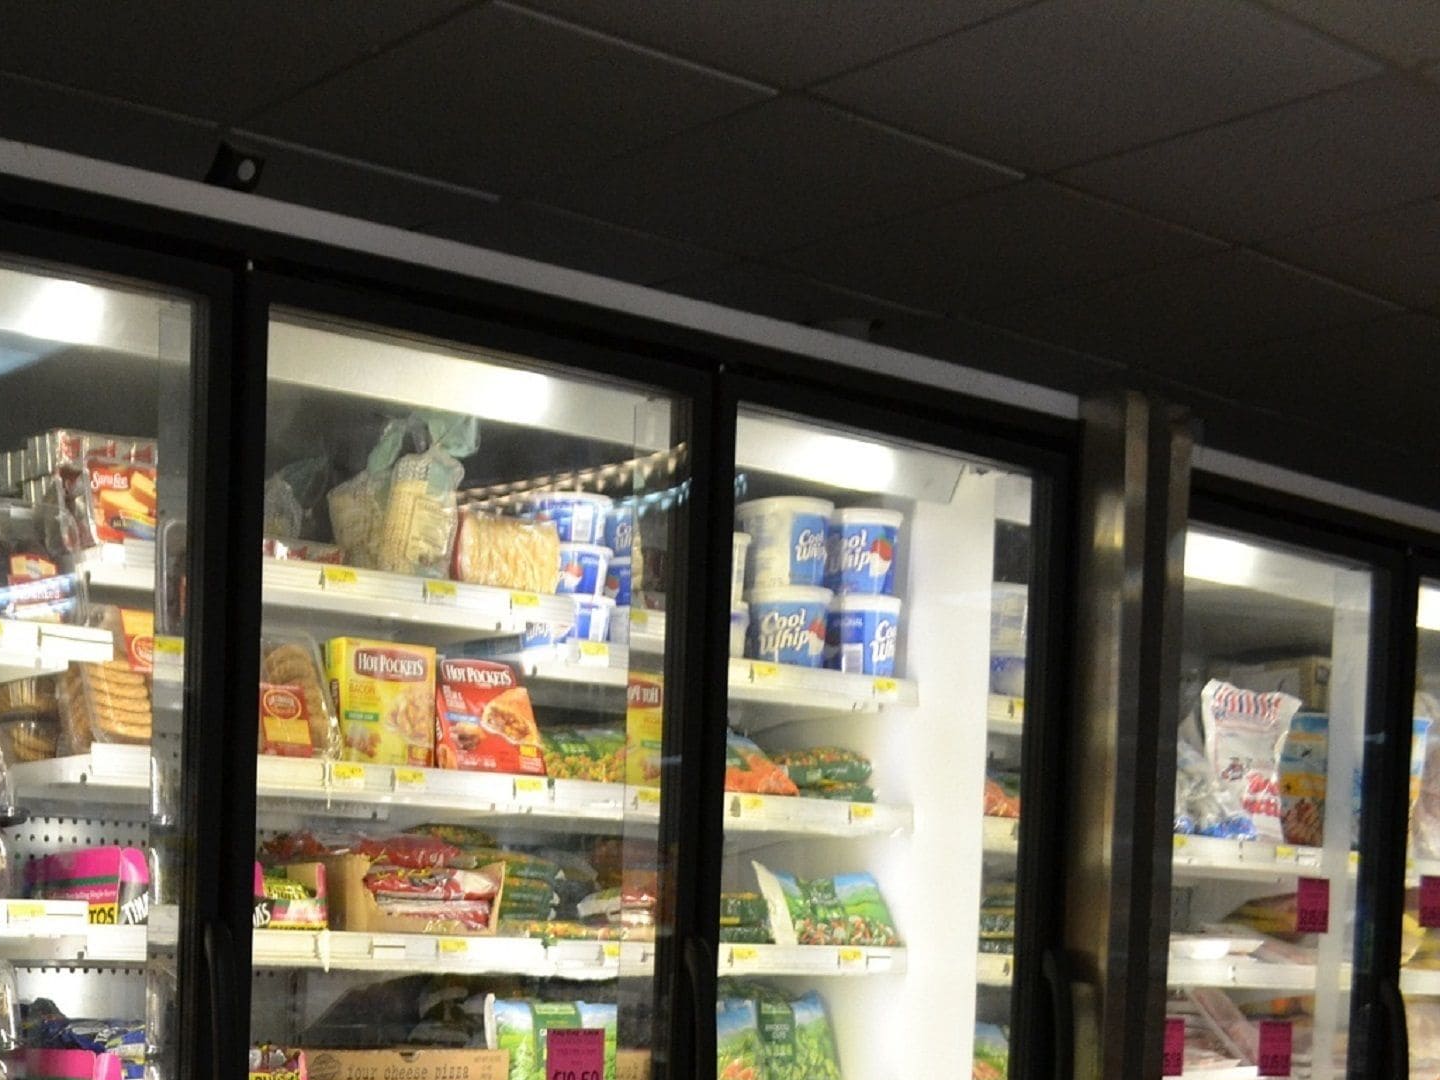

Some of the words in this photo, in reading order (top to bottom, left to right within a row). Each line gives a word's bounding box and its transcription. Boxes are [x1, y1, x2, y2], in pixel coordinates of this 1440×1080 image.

[761, 607, 807, 633] Cool
[760, 628, 810, 655] Whip
[379, 655, 424, 677] POCKETS
[465, 665, 512, 686] POCKETS
[346, 1064, 378, 1080] four
[383, 1062, 430, 1080] cheese
